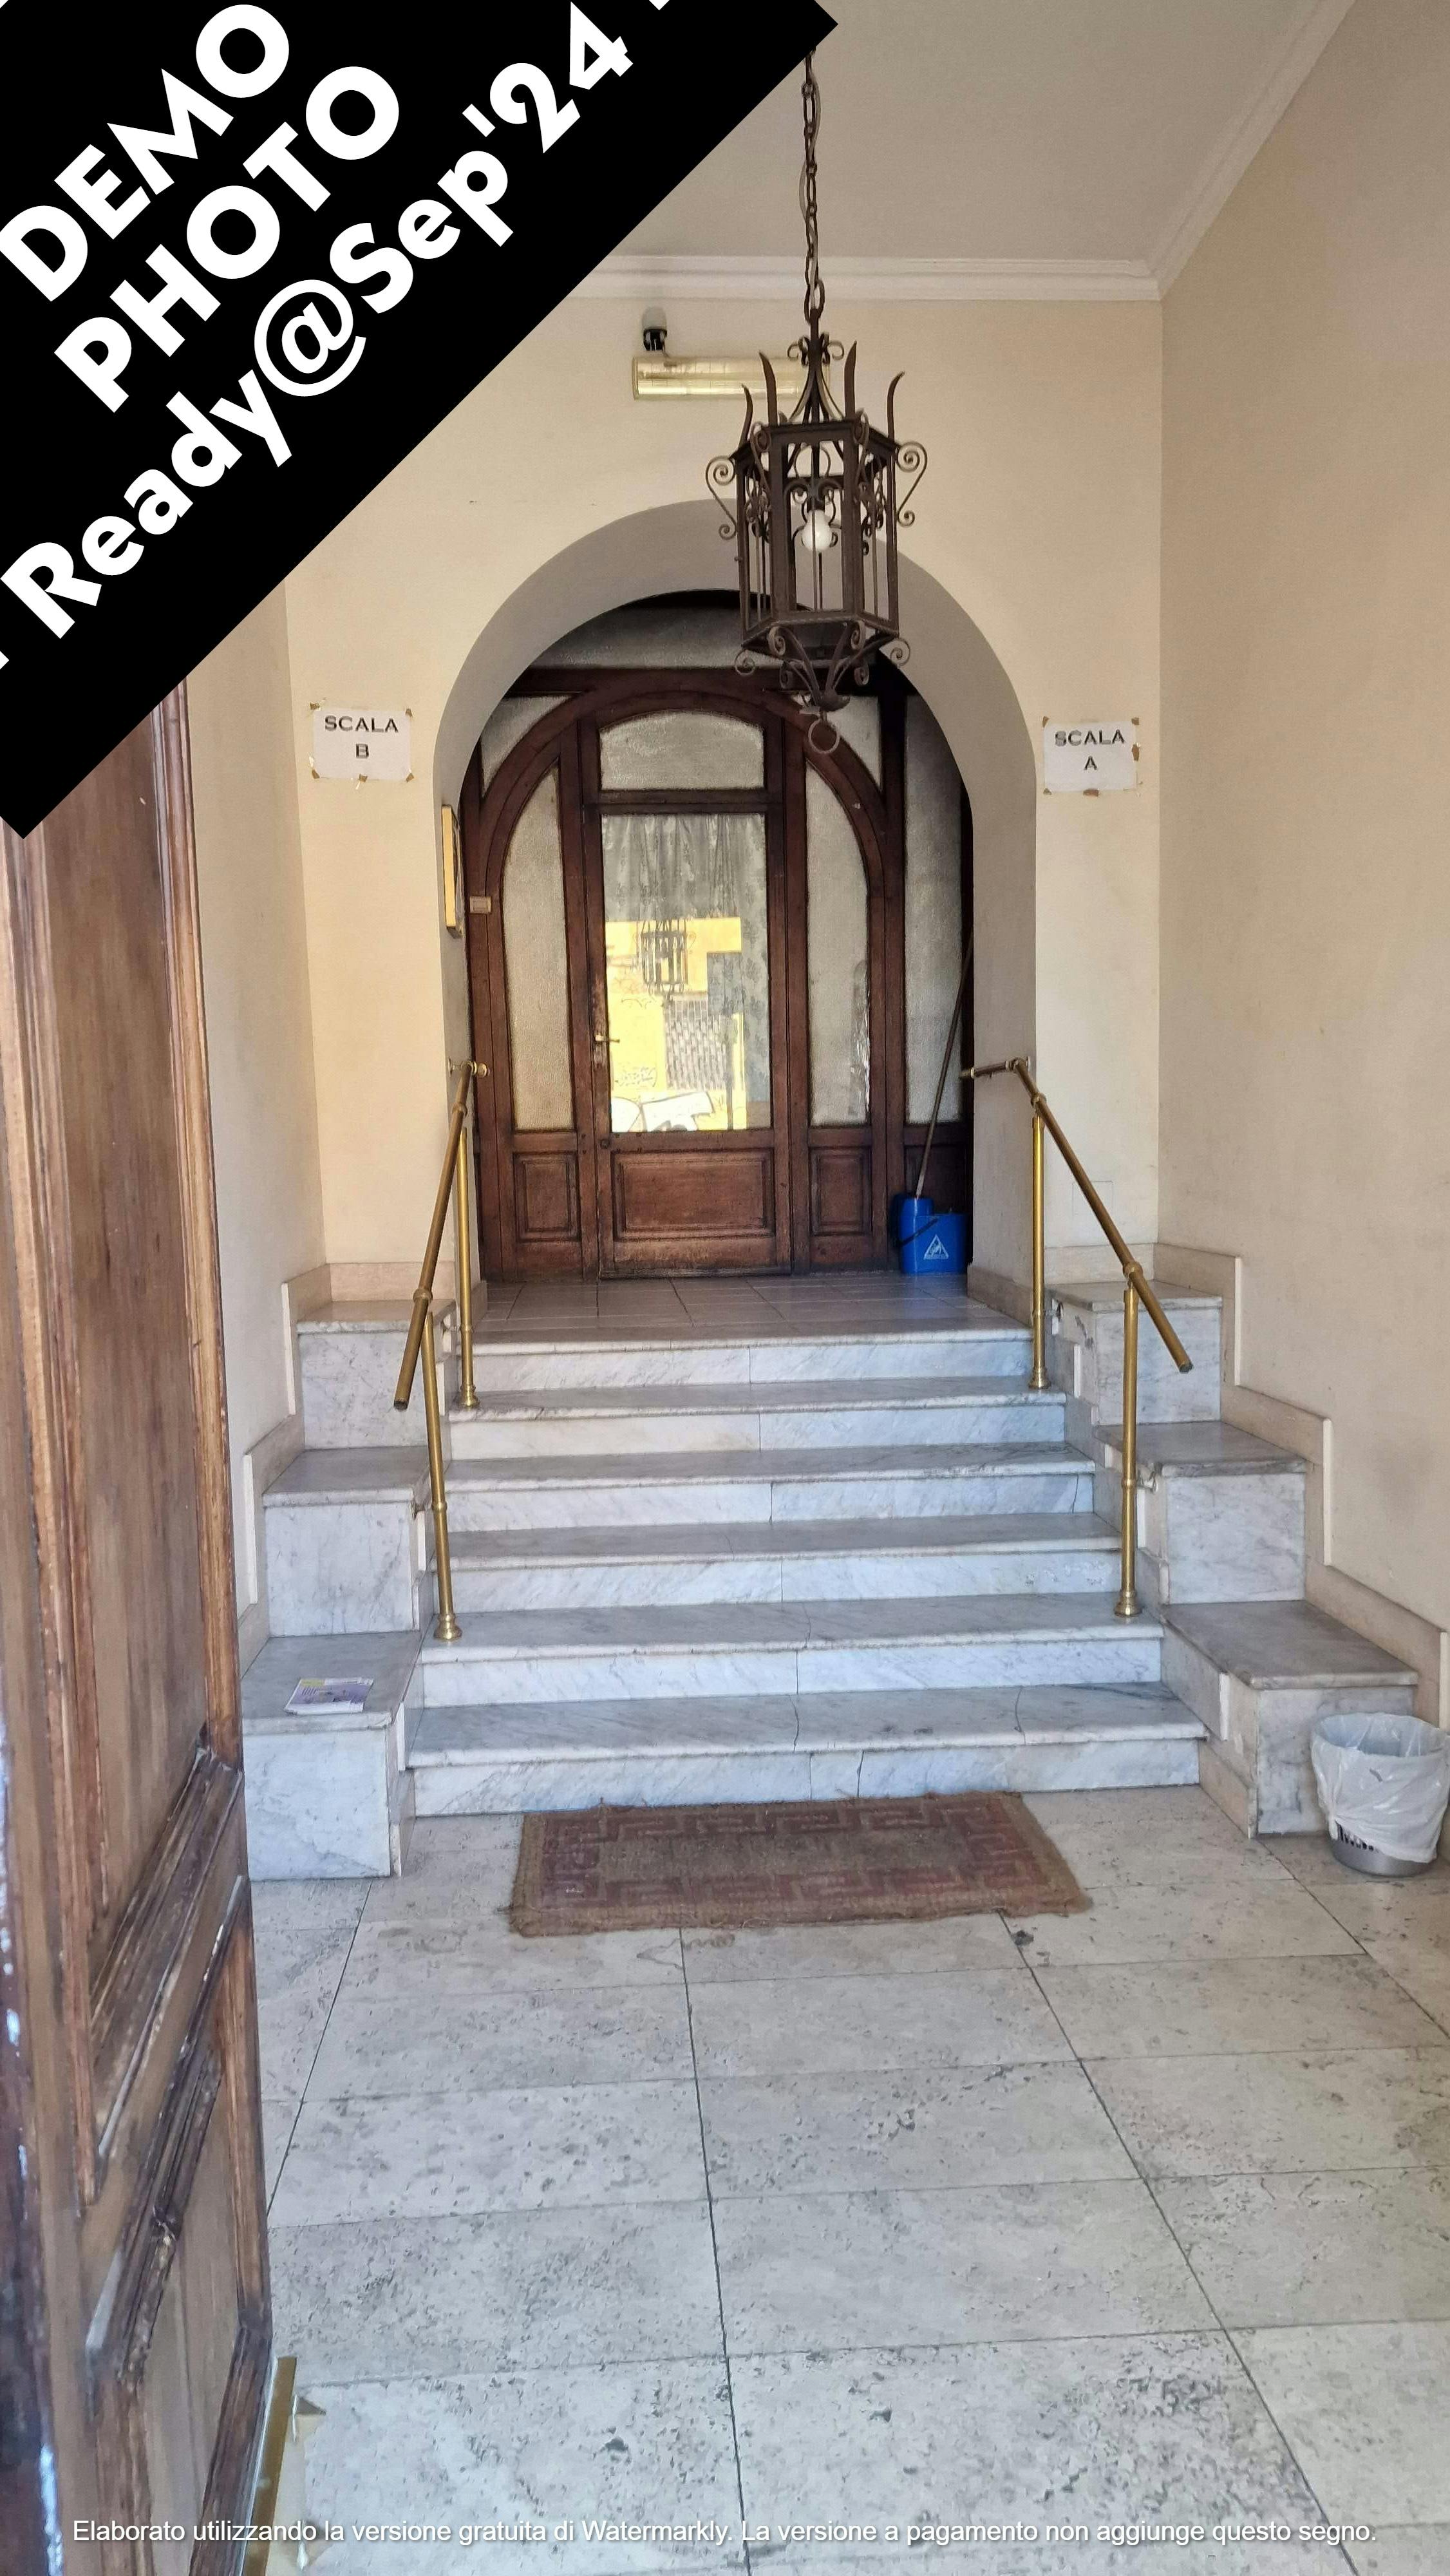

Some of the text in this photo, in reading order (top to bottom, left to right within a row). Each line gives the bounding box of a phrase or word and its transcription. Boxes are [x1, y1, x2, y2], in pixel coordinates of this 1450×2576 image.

[325, 715, 399, 733] SCALA
[1055, 729, 1125, 746] SCALA
[355, 743, 370, 759] B
[1084, 755, 1098, 771] A
